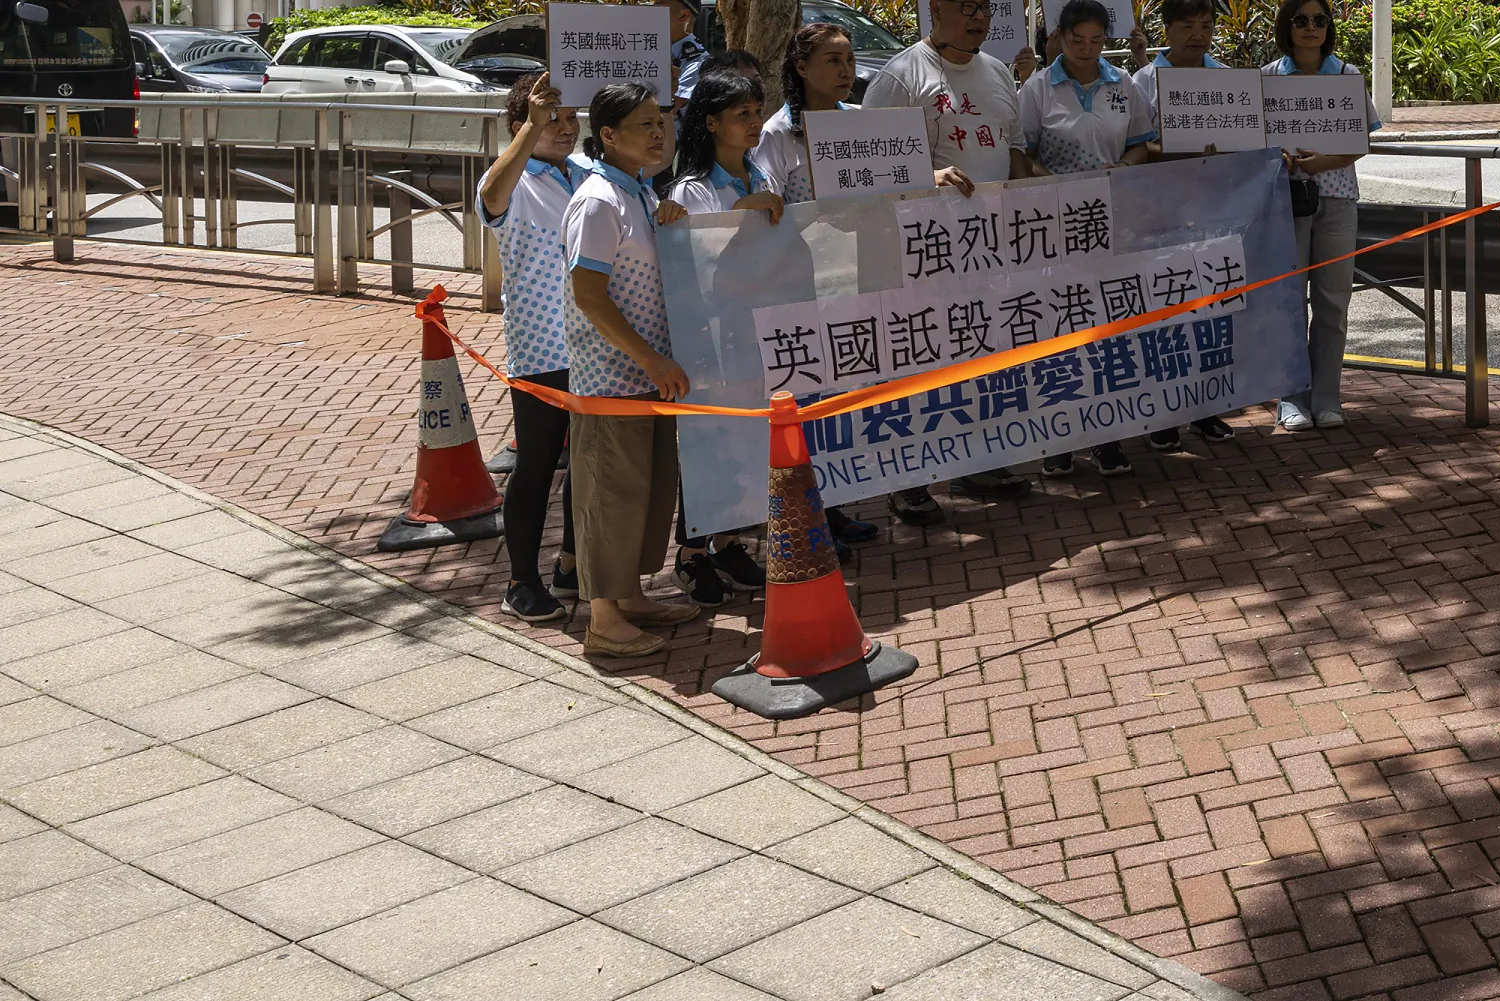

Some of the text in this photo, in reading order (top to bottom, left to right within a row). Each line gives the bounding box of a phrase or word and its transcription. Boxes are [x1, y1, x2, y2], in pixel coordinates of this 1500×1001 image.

[561, 31, 658, 51] 英國無恥干預
[561, 60, 659, 79] 香港特區法治
[1169, 90, 1251, 106] 懸紅通緝 8 名
[1328, 98, 1335, 109] 8
[1340, 96, 1354, 110] 名
[1163, 113, 1260, 129] 逃港者合法有理
[814, 136, 923, 161] 英國無的放矢
[838, 165, 910, 189] 亂噏一通
[903, 198, 1110, 279] 強烈抗議
[763, 256, 1244, 391] 英國詆毀香港國安法
[877, 431, 973, 477] HEART
[983, 412, 1071, 453] HONG
[1079, 392, 1156, 431] KONG
[1163, 372, 1235, 412] UNION
